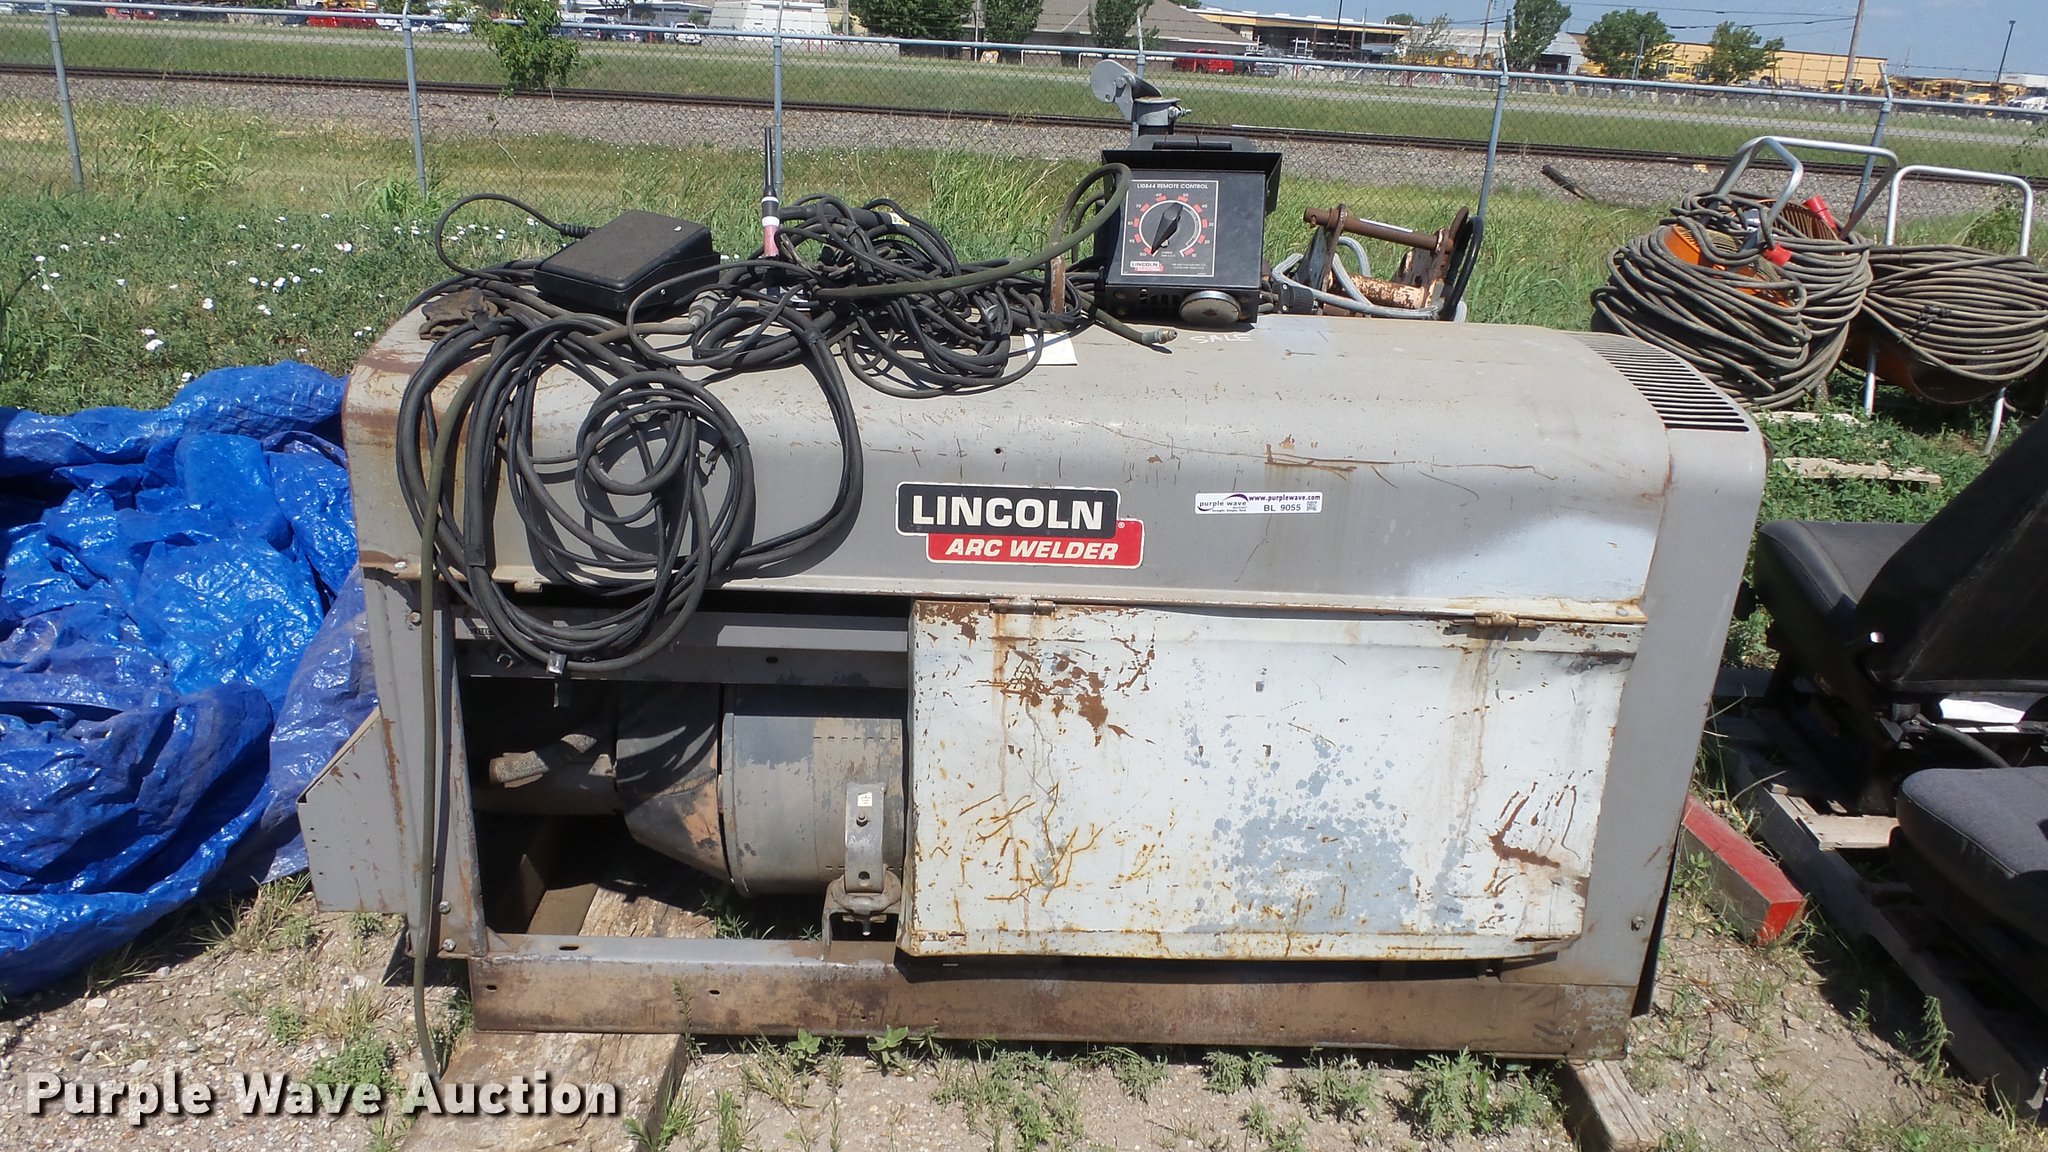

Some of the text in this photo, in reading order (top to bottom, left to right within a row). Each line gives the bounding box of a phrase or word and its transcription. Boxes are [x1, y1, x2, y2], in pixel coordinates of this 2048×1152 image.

[1248, 494, 1321, 503] www.purplewave.com
[912, 495, 1104, 530] LINCOLN
[945, 538, 1119, 560] ARC WELDER
